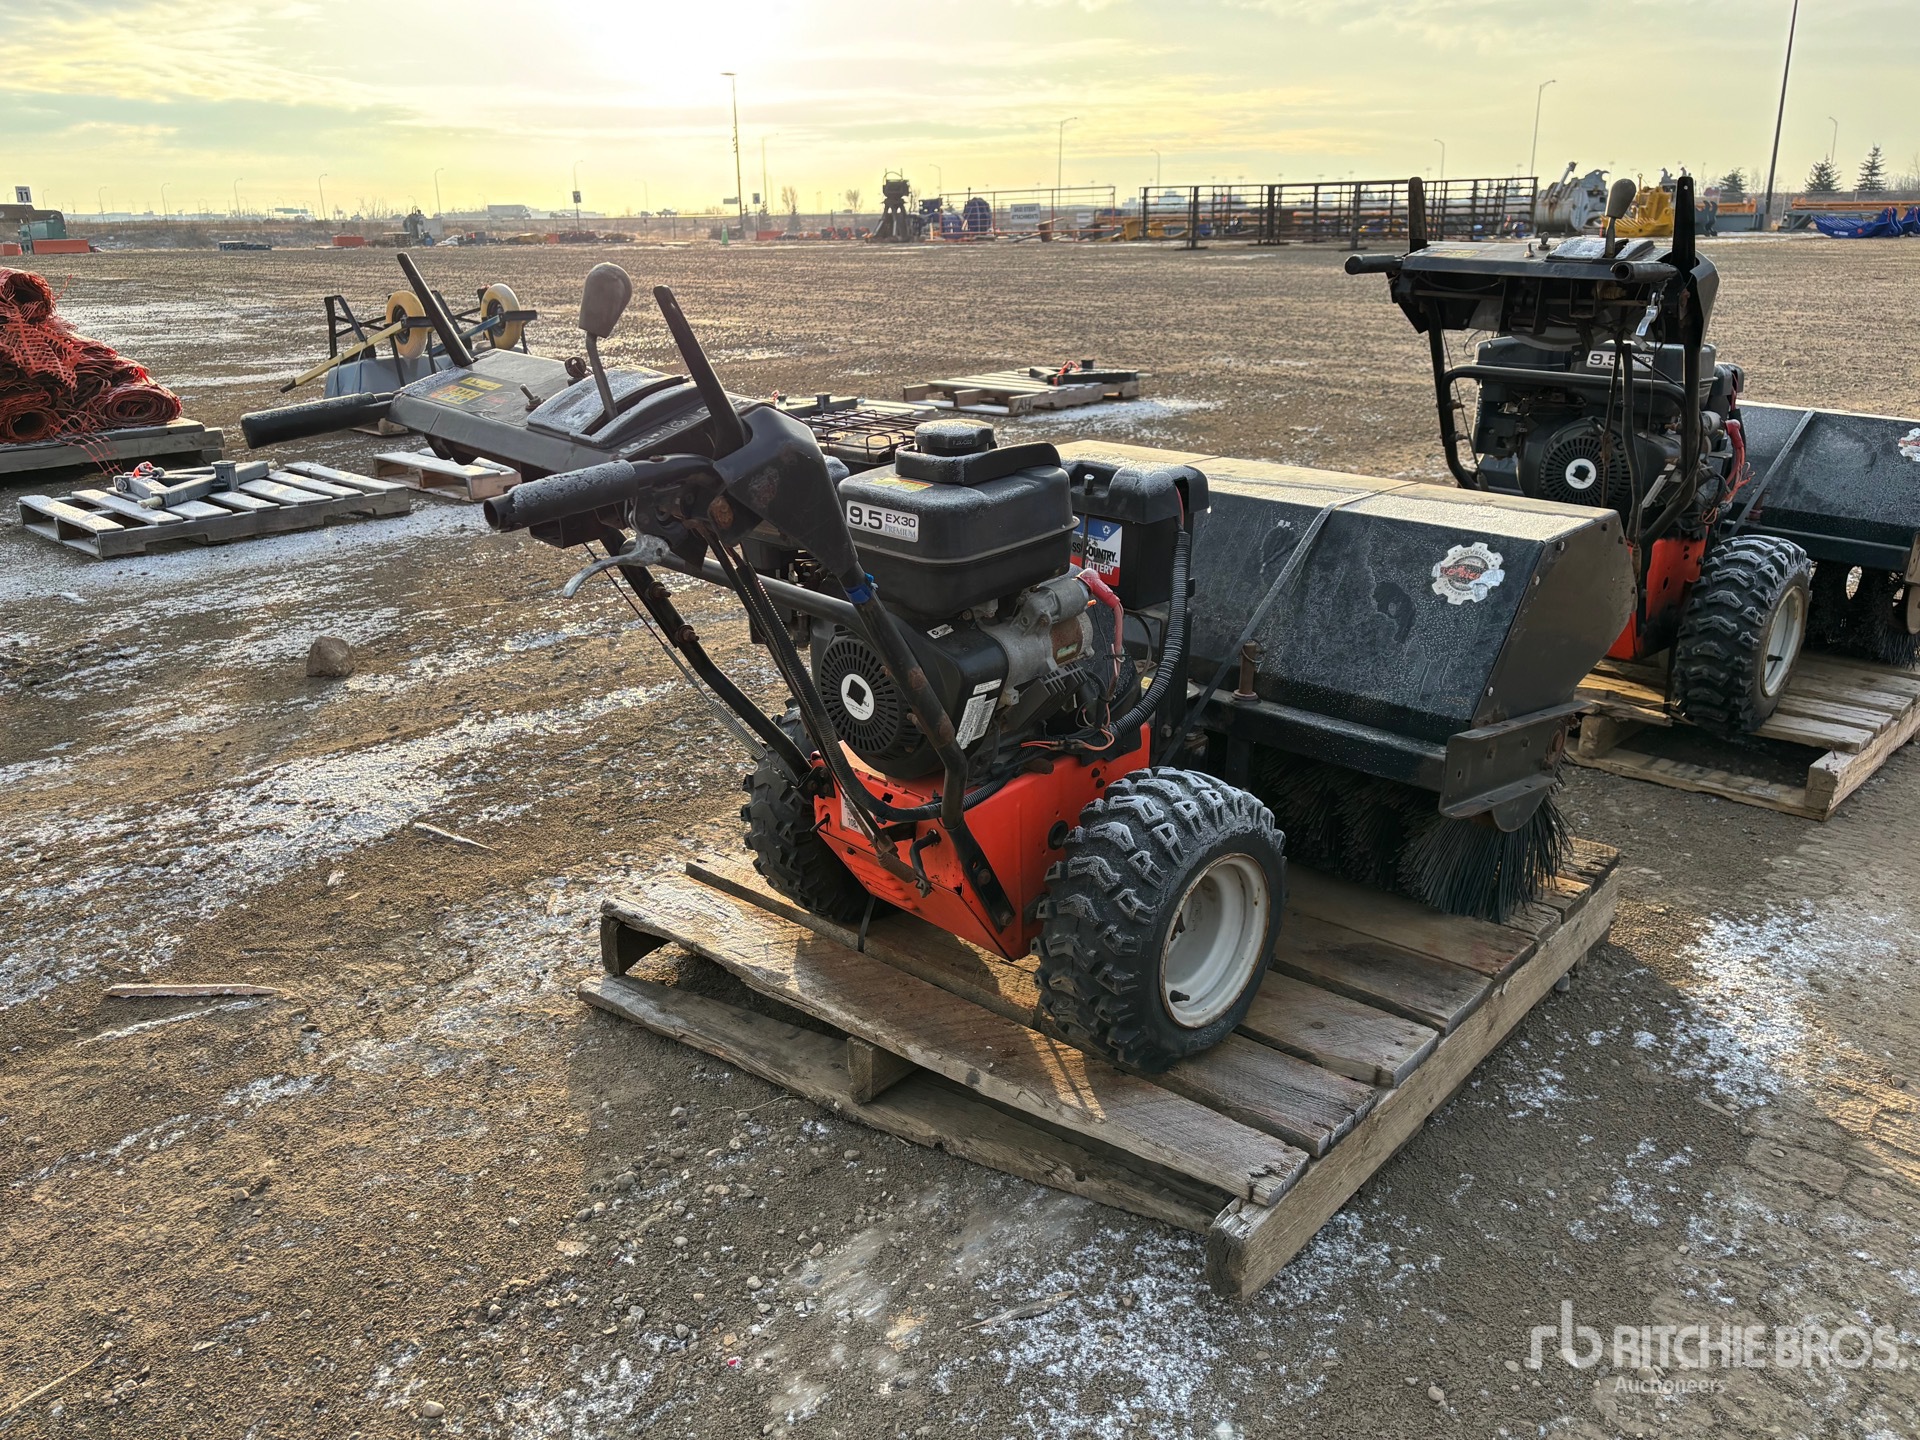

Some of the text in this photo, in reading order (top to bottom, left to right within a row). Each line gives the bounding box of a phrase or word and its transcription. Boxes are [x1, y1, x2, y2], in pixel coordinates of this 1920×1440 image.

[18, 191, 29, 201] 11
[849, 505, 916, 529] 9.5 EX30
[884, 524, 916, 539] PREMIUM
